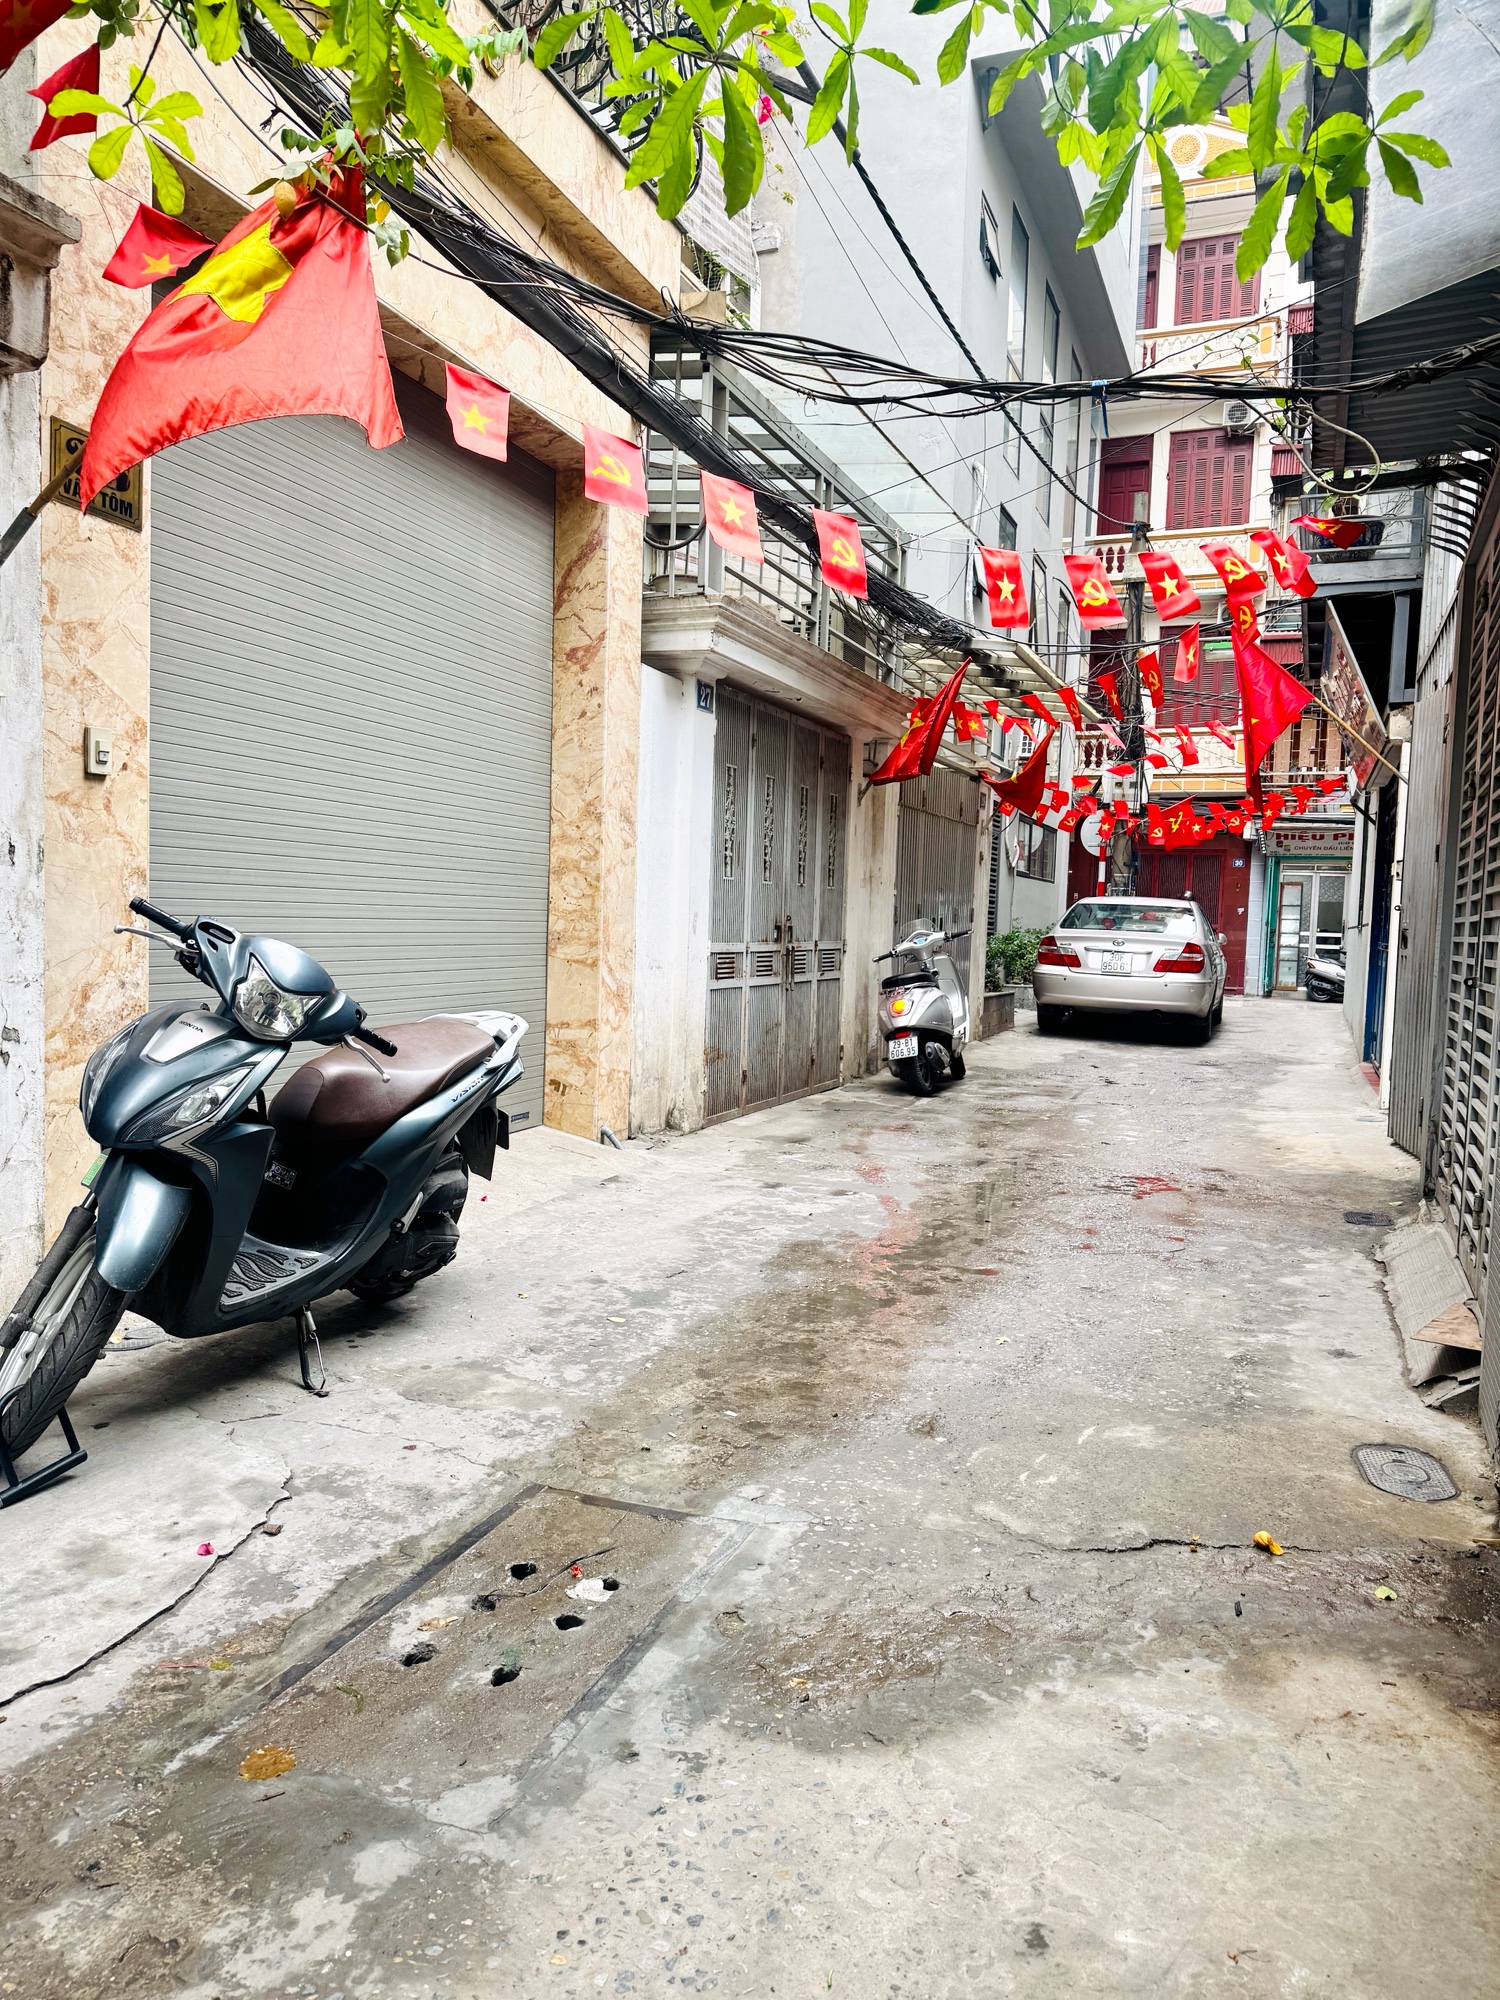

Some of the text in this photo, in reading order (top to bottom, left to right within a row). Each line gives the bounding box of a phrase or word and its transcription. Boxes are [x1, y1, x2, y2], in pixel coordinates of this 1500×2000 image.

[100, 492, 133, 518] TÔM
[700, 686, 711, 708] 27
[1276, 831, 1325, 842] HIỆU
[1109, 953, 1125, 961] 30F
[178, 1020, 204, 1033] HONDA
